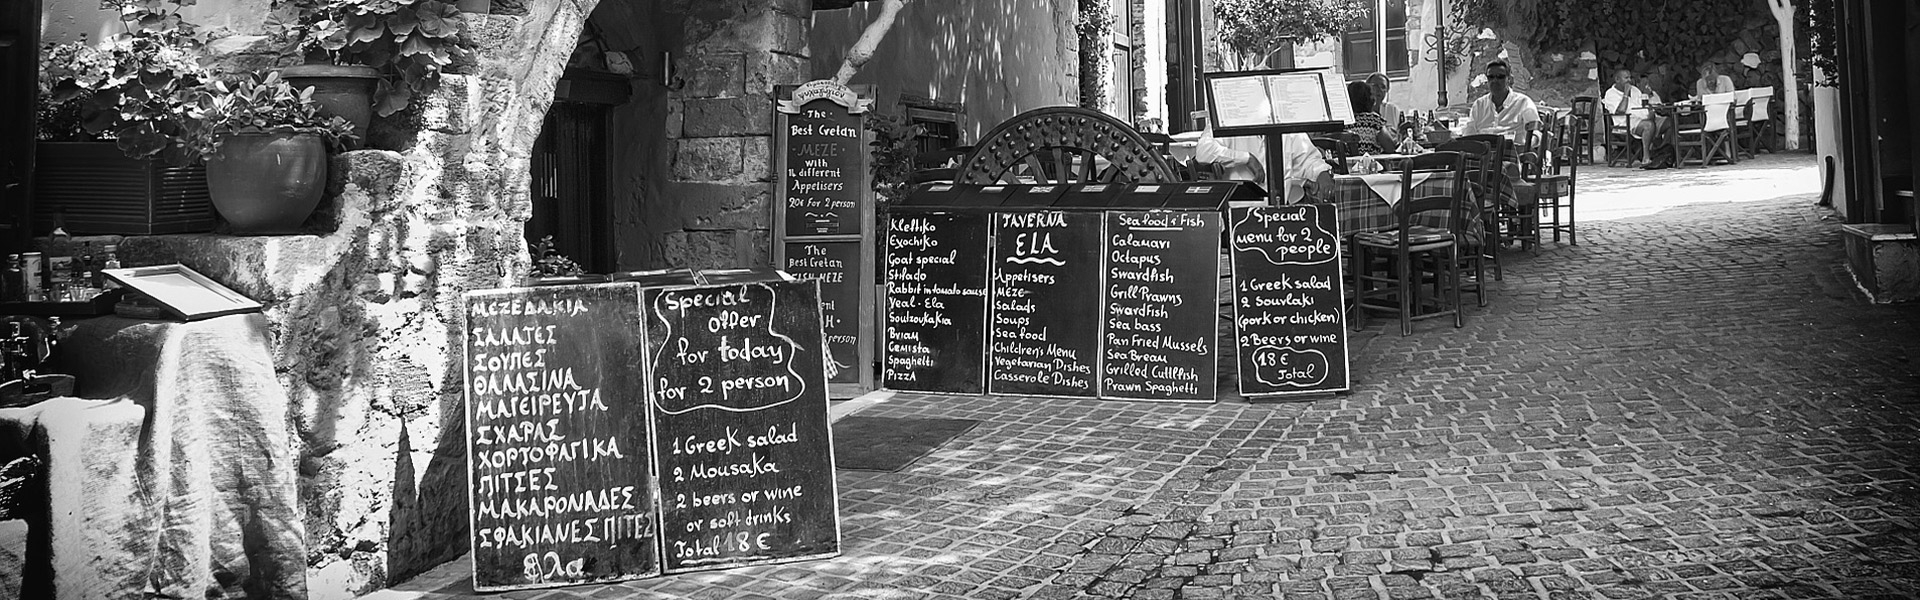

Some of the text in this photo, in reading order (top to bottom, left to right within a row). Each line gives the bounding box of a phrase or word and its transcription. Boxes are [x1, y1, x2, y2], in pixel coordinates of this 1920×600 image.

[807, 109, 826, 119] The
[791, 124, 857, 138] Best Cretan
[797, 143, 838, 157] MEZE
[799, 167, 841, 177] different
[805, 159, 828, 168] with
[791, 179, 844, 194] Appetisers
[824, 197, 831, 207] 2
[830, 200, 856, 210] person
[890, 217, 937, 235] Kleftiko
[1002, 212, 1068, 229] TAVERNA
[1119, 213, 1141, 226] Sea
[1141, 213, 1168, 228] food
[1180, 213, 1205, 228] Fish
[1253, 207, 1307, 229] Special
[1112, 233, 1170, 249] Calamari
[1276, 226, 1297, 243] for
[1300, 227, 1313, 242] 2
[804, 244, 827, 256] The
[1016, 231, 1059, 256] ELA
[1275, 238, 1331, 261] people
[788, 257, 843, 269] Best Cretan
[888, 249, 957, 270] Goat special
[1111, 249, 1161, 269] Octapus
[888, 267, 927, 282] Stifado
[1111, 266, 1174, 284] Swardfish
[1239, 273, 1332, 292] 1 Greek salad
[886, 281, 922, 296] Rabbit
[923, 284, 932, 295] in
[996, 287, 1026, 298] MEZE
[1110, 284, 1183, 307] Grill Prawns
[665, 284, 750, 318] Special
[924, 297, 945, 310] Ela
[1240, 296, 1251, 308] 2
[996, 313, 1030, 329] Soups
[1109, 318, 1162, 332] Sea bass
[1273, 316, 1288, 325] or
[472, 324, 557, 347] ΣΑΛΑΤΕΣ
[827, 334, 857, 346] person
[995, 326, 1047, 341] Sea food
[1240, 333, 1338, 347] 2 Beers or wine
[676, 335, 784, 366] for today
[994, 341, 1077, 360] Children's Menu
[1106, 333, 1208, 356] Pan Fried Mussels
[472, 348, 547, 373] ΣΟΥΠΕΣ
[888, 355, 934, 370] Spaghetti
[1107, 348, 1128, 360] Sea
[1257, 352, 1289, 367] 18 €
[994, 356, 1091, 375] Vegetarian Dishes
[1106, 362, 1149, 379] Grilled
[1278, 363, 1315, 380] Total
[473, 367, 582, 396] ΘΑΛΑΣΙΝΑ
[657, 374, 790, 401] for 2 person
[994, 369, 1089, 390] Casserole Dishes
[1104, 377, 1198, 397] Prawn Spaghetti
[475, 387, 609, 421] ΜΑΓΕΙΡΕΥΤΑ
[672, 422, 799, 455] 1 Greek salad
[478, 435, 624, 470] ΧΟΡΤΟΦΑΓΙΚΑ
[478, 467, 559, 498] ΠΙΤΣΕΣ
[673, 466, 685, 483] 2
[477, 485, 635, 522] ΜΑΚΑΡΟΝΑΔΕΣ
[676, 485, 803, 509] 2 beers or wine
[686, 518, 704, 533] or
[709, 511, 742, 530] soft
[478, 517, 601, 550] ΣΦΑΚΙΑΝΕΣ
[674, 531, 772, 559] Total 18 €
